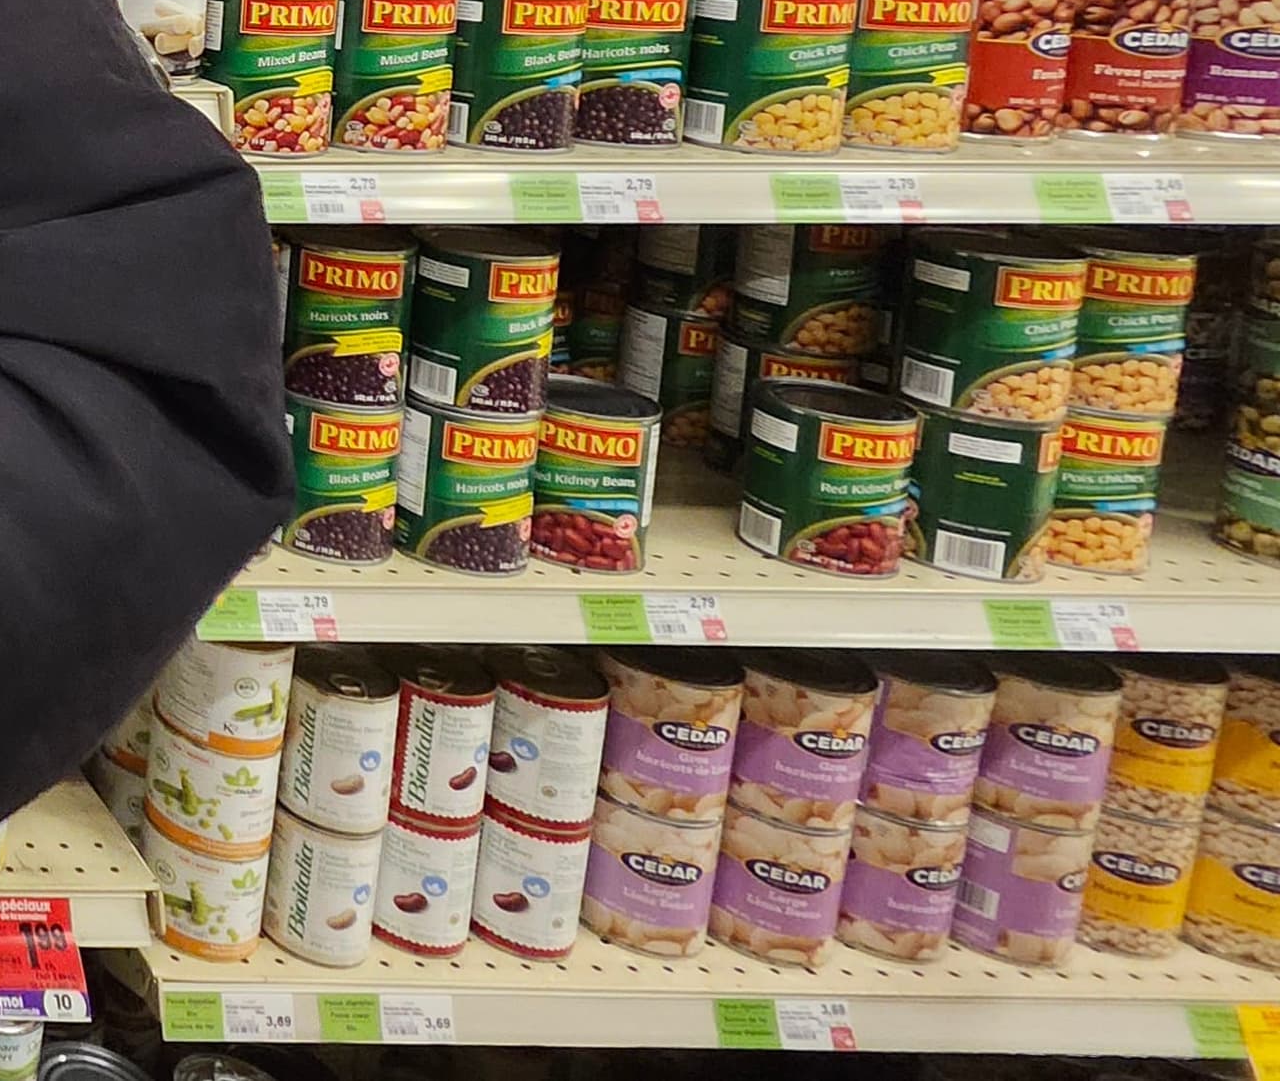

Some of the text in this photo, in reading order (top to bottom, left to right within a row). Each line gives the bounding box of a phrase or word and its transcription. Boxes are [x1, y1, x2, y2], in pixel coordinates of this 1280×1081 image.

[250, 1, 334, 27] PRIMO
[582, 43, 669, 60] Haricots noirs
[888, 46, 927, 58] Chick
[258, 54, 295, 67] Mixed
[350, 178, 377, 191] 2,79
[306, 260, 397, 292] PRIMO
[310, 309, 389, 323] Haricots noirs
[555, 472, 635, 487] Kidney Beans
[661, 723, 728, 744] CEDAR
[292, 704, 317, 804] Bioitalia
[408, 705, 435, 804] Bioitalia
[0, 996, 23, 1009] moi
[56, 994, 72, 1009] 10
